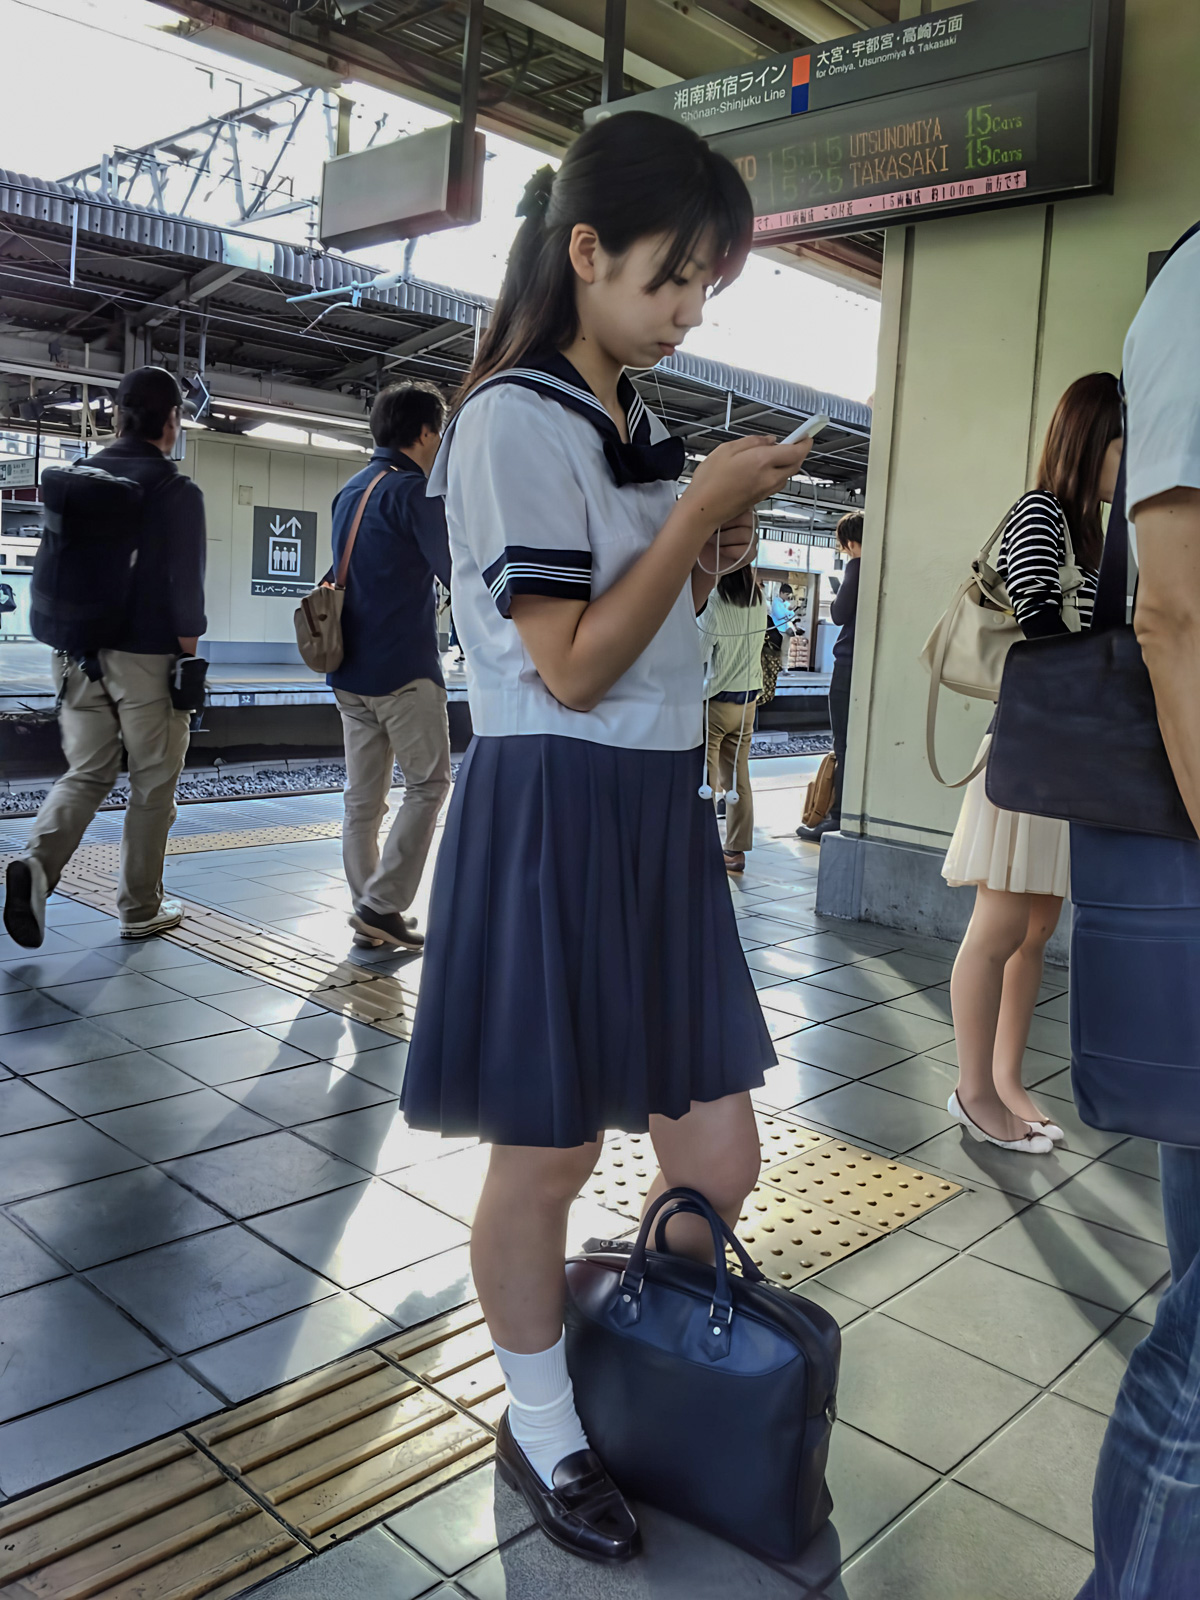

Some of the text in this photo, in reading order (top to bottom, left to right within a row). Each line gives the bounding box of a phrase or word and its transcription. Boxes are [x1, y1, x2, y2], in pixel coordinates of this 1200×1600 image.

[816, 69, 827, 79] for
[858, 49, 907, 68] Utsunomiya
[909, 46, 915, 56] &
[918, 34, 957, 53] Takasaki
[673, 64, 787, 110] 湘南新宿ライン
[764, 88, 786, 103] Line
[849, 117, 942, 157] UTSUNOMIYA
[849, 144, 949, 189] TAKASAKI
[254, 585, 294, 594] エレベーター
